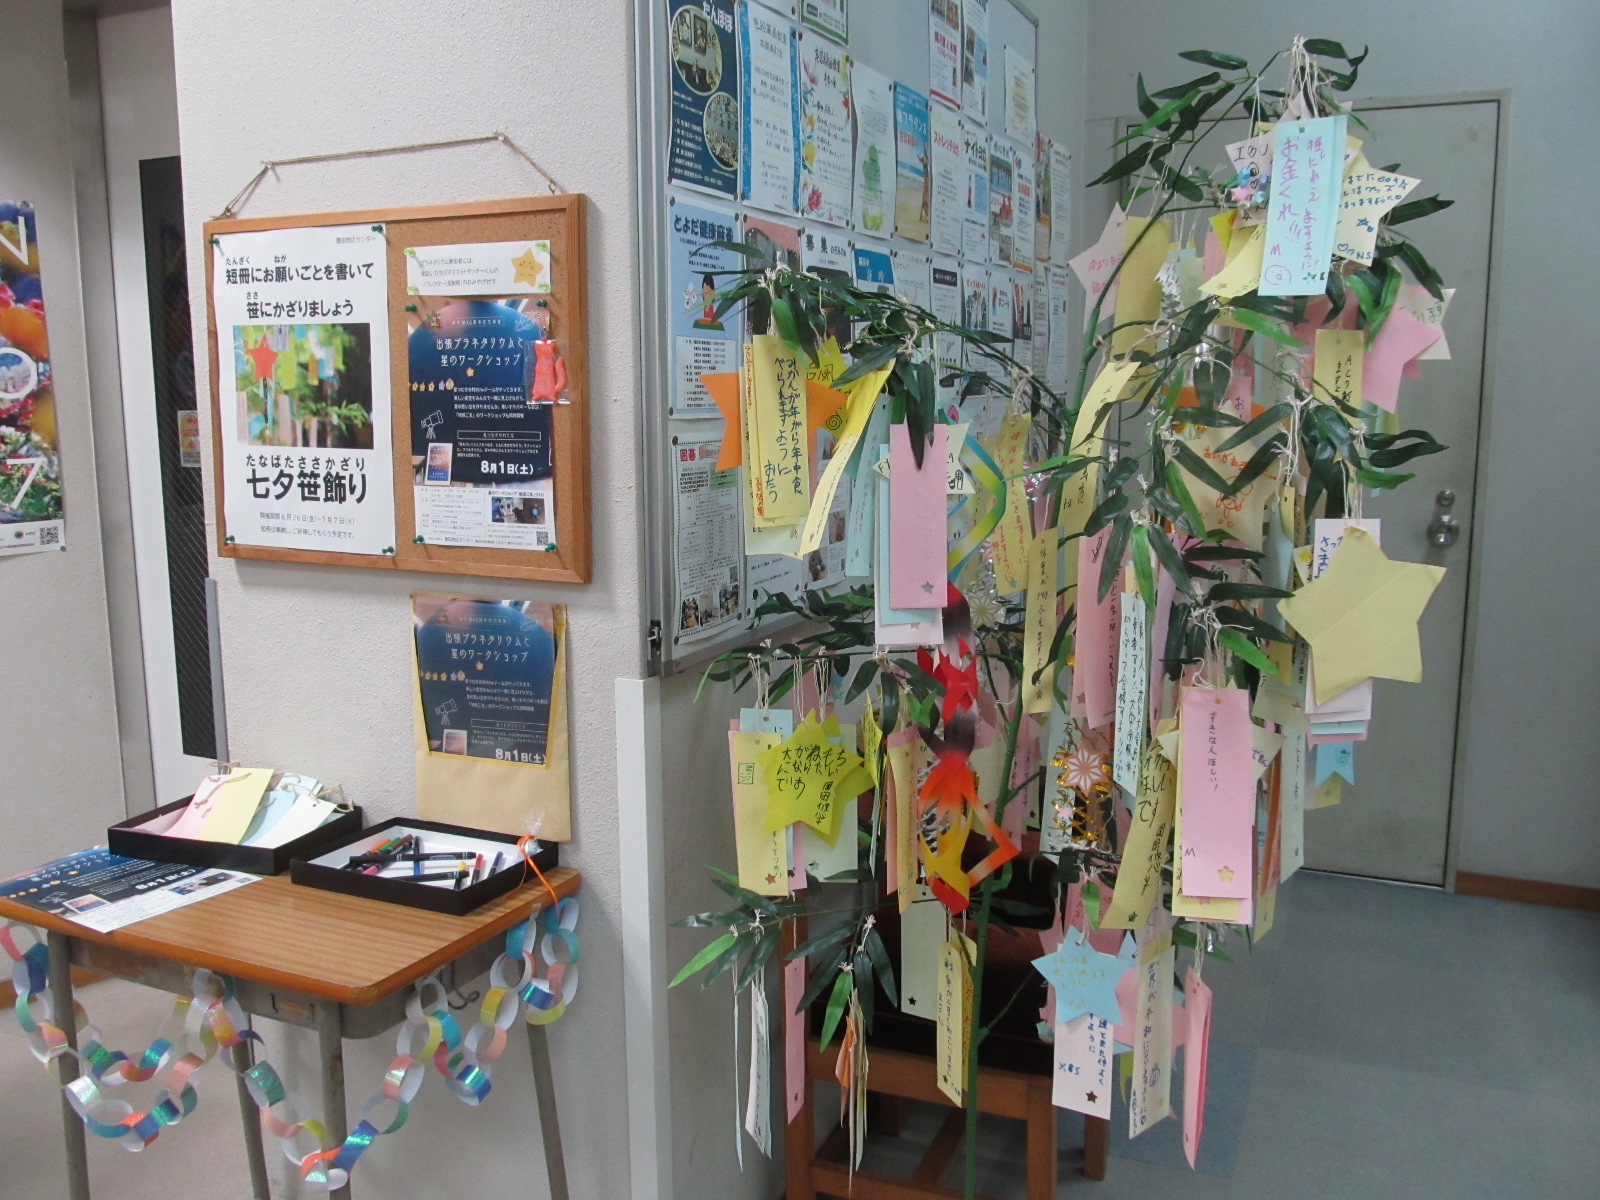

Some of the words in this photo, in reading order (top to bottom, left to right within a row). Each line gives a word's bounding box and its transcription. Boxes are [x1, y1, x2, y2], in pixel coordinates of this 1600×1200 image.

[225, 256, 251, 265] たんざく
[274, 254, 287, 264] ねが
[226, 262, 374, 285] 短冊にお願いごとを書いて
[246, 291, 259, 300] ささ
[246, 300, 354, 319] 笹にかざりましょう
[436, 337, 524, 350] 出張プラネタリウムと
[440, 354, 522, 367] 星のワークショップ
[246, 453, 365, 472] たなばたささかざり
[481, 461, 534, 475] 8月1日(土)
[246, 468, 367, 504] 七夕笹飾り
[445, 633, 531, 648] 出張プラネタリウムと
[451, 648, 528, 662] 星のワークショップ
